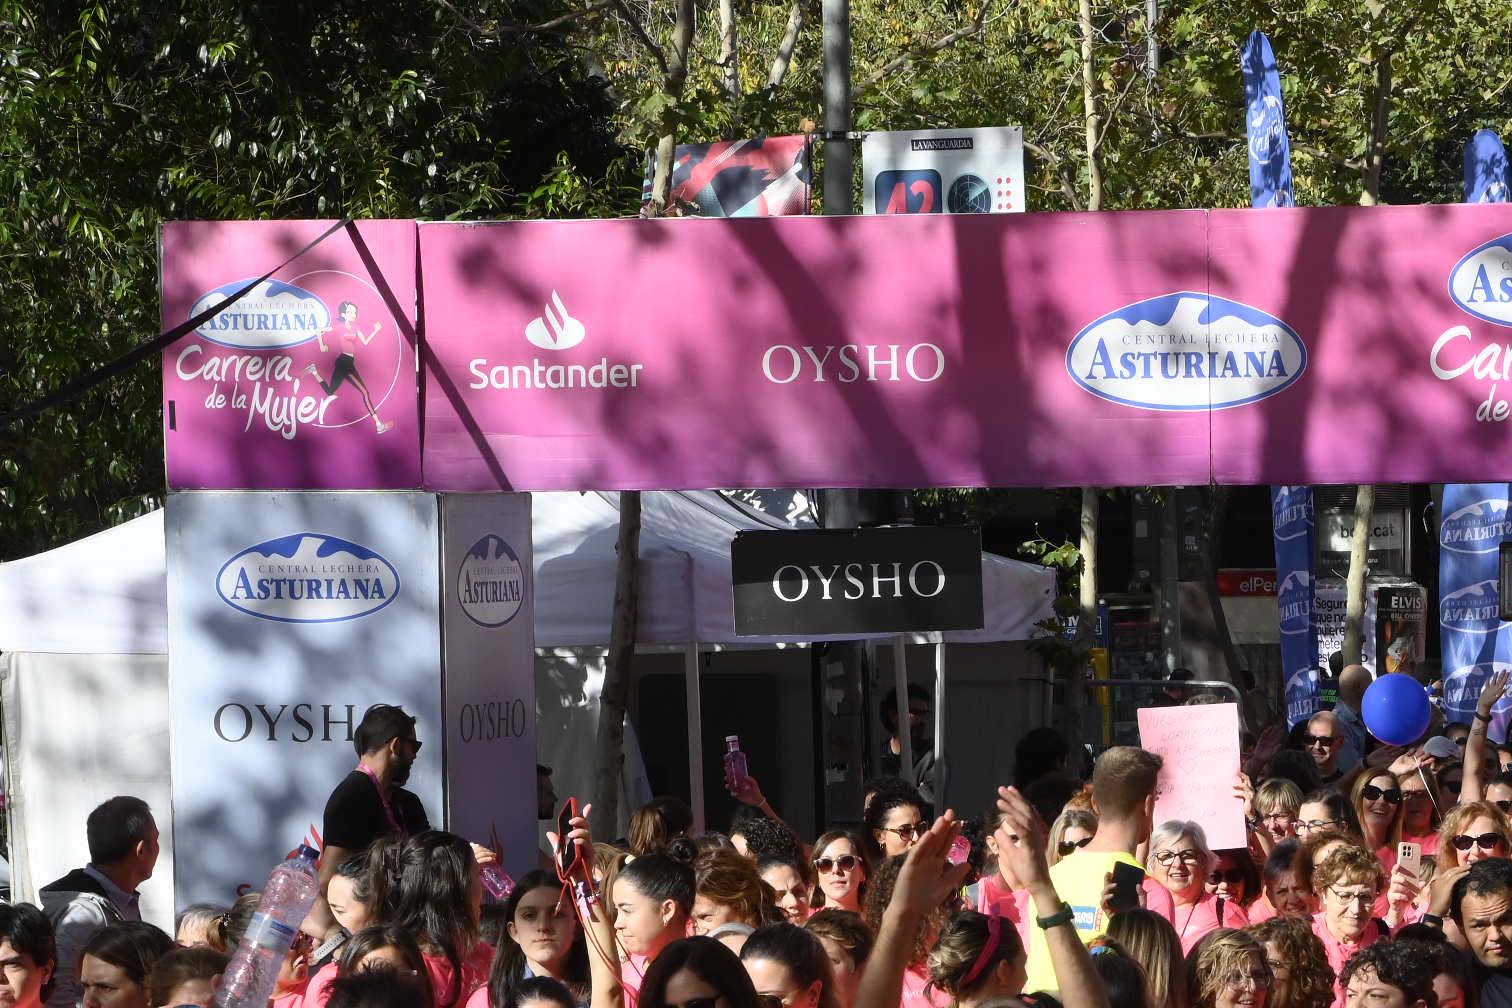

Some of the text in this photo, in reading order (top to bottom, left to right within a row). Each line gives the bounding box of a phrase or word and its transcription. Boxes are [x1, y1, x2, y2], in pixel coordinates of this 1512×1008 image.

[200, 303, 319, 331] ASTURIANA
[1121, 331, 1280, 345] CENTRAL LECHERA
[175, 344, 294, 382] Carrera
[469, 357, 644, 390] Santander
[761, 342, 946, 384] OYSHO
[1085, 337, 1289, 380] ASTURIANA
[205, 381, 248, 409] de la
[244, 378, 339, 440] Mujer
[1476, 384, 1510, 422] de
[230, 566, 387, 601] ASTURIANA
[258, 563, 380, 575] CENTRAL LECHERA
[462, 568, 521, 605] ASTURIANA
[771, 559, 946, 603] OYSHO
[1391, 596, 1422, 609] ELVIS
[213, 702, 403, 743] OYSH
[460, 698, 526, 743] OYSHO
